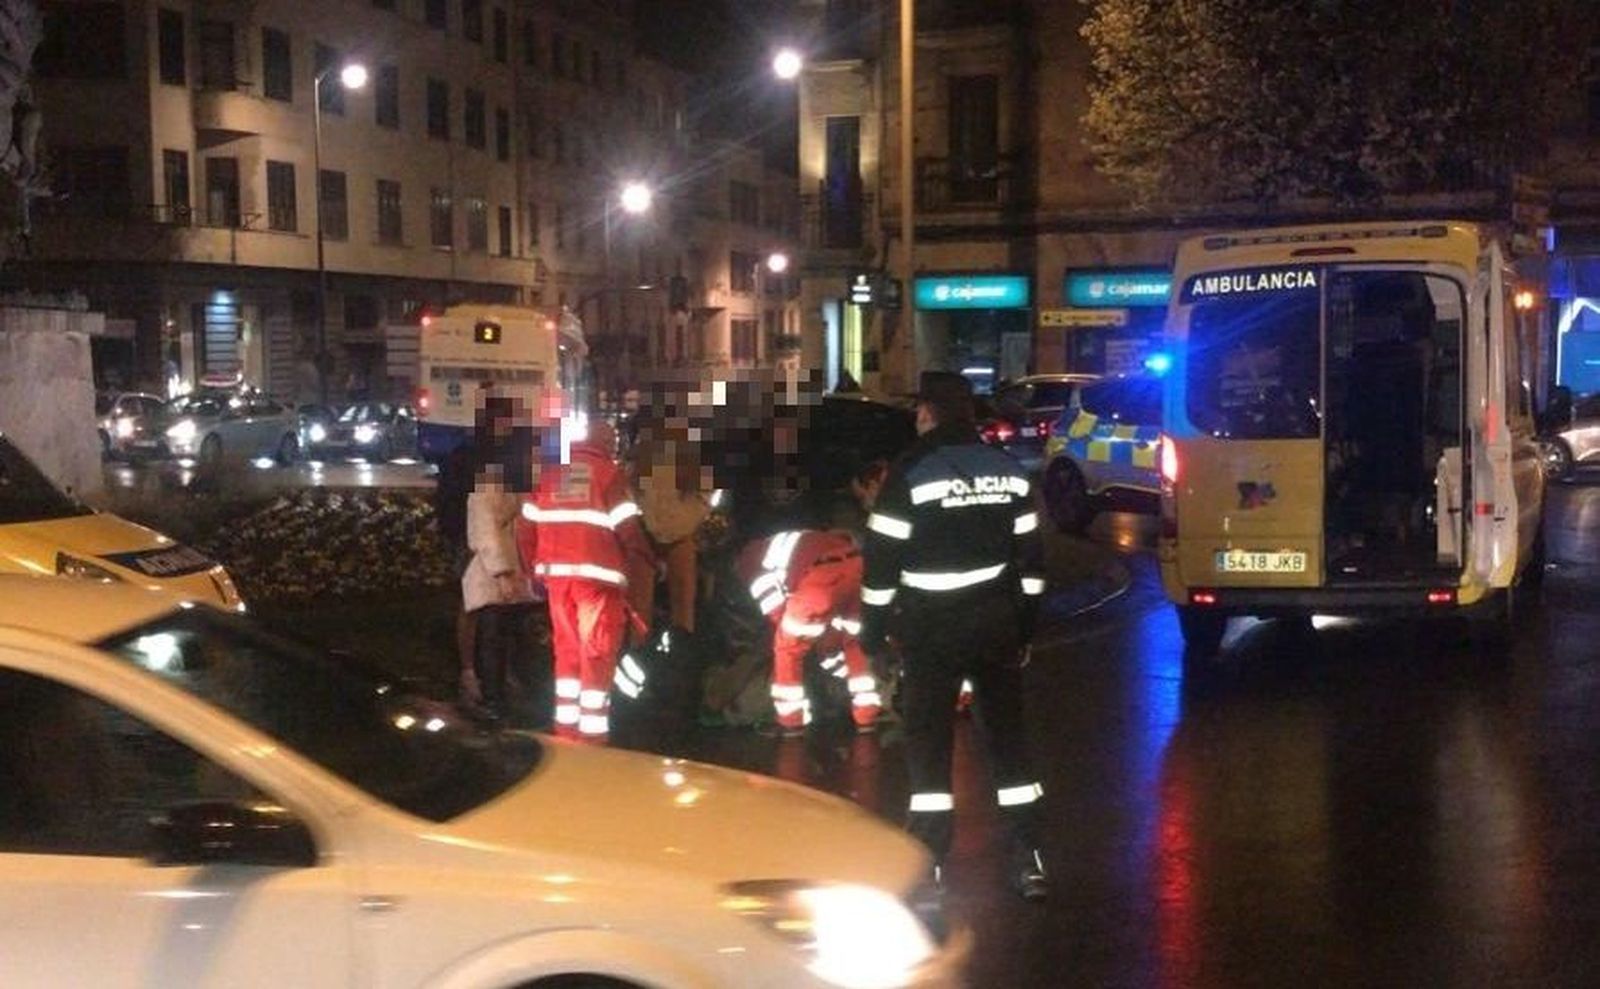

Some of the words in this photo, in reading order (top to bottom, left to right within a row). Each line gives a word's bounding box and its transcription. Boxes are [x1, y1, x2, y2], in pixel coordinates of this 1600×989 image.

[1106, 280, 1170, 297] cajamar
[1191, 270, 1317, 297] AMBULANCIA
[951, 284, 1008, 300] cajamar
[1227, 554, 1267, 570] 5418
[1273, 554, 1302, 570] JKB
